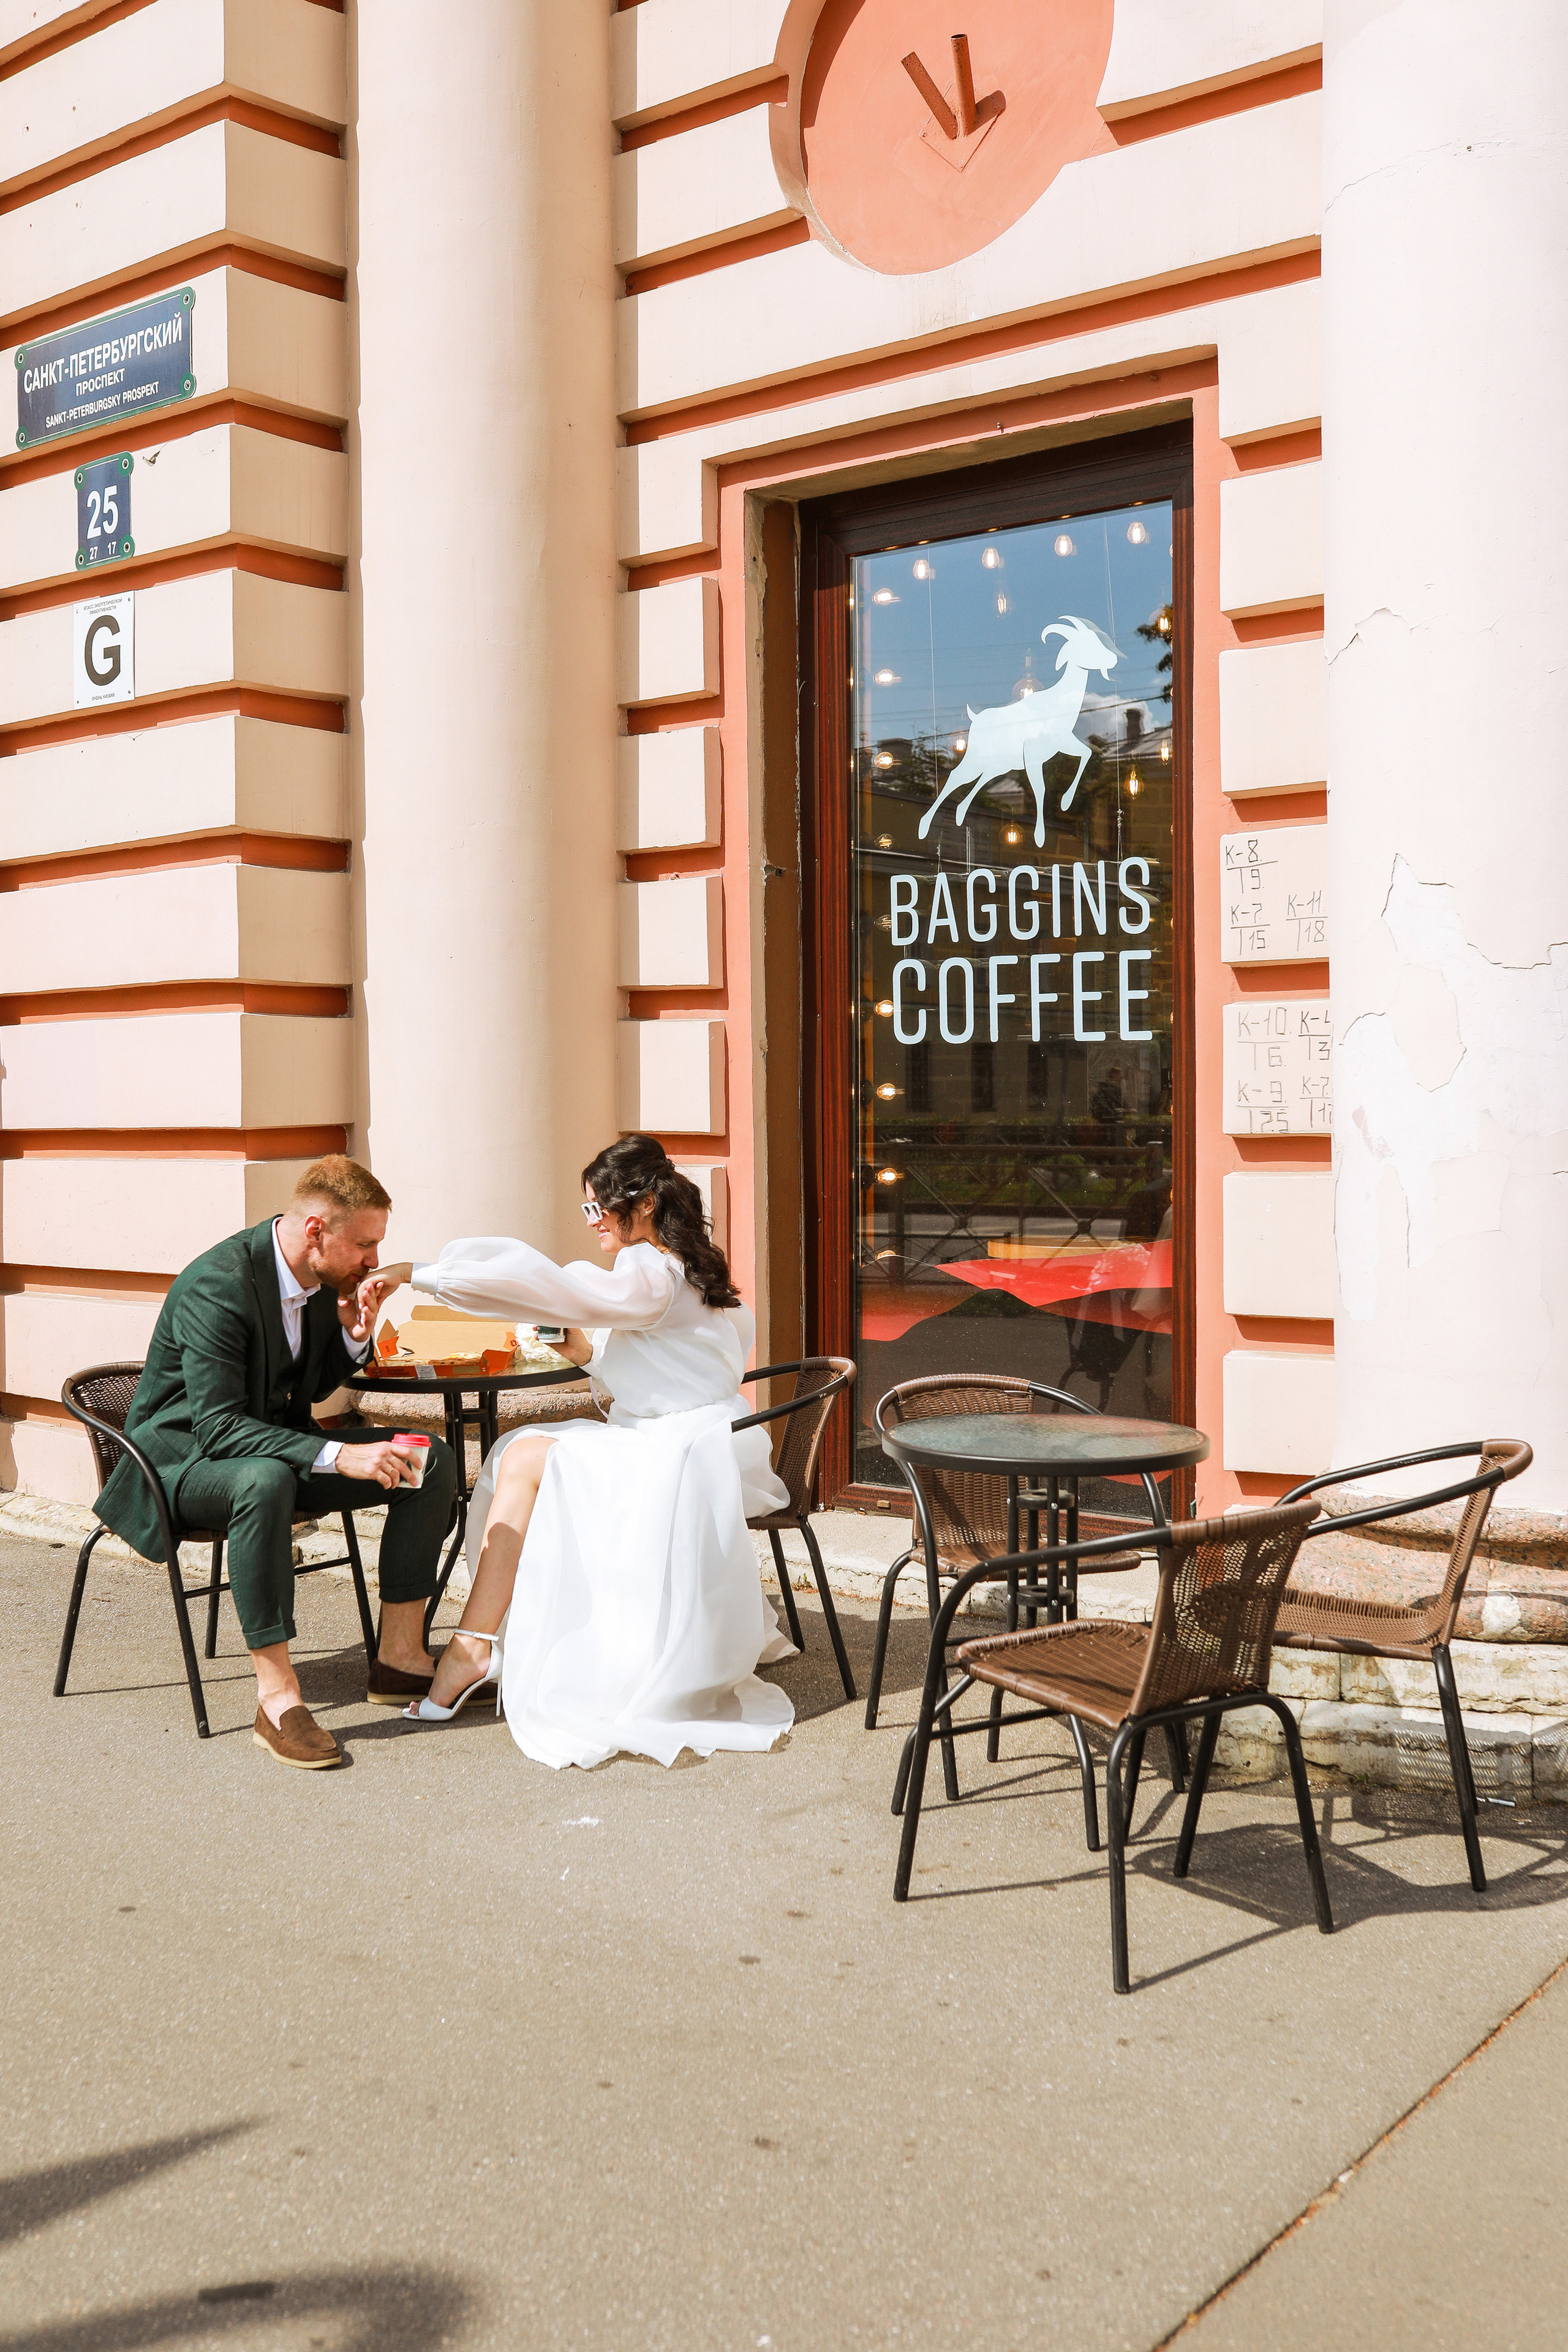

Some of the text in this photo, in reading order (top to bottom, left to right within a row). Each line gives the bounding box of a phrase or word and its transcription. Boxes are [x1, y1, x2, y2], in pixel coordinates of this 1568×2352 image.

[23, 311, 183, 394] САНКТ-ПЕТЕРБУРГСКИЙ
[45, 381, 159, 428] SANKT-PETERBURGSKY PROSPEKT
[75, 368, 125, 396] ПРОСПЕКТ
[86, 484, 119, 540] 25
[89, 541, 117, 560] 27 17
[89, 605, 116, 615] ЭФФЕКТИВНОСТИ
[94, 597, 123, 609] ЭНЕРГЕТИЧЕСКОЙ
[85, 614, 121, 686] G
[891, 856, 1151, 946] BAGGINS
[892, 949, 1153, 1045] COFFEE
